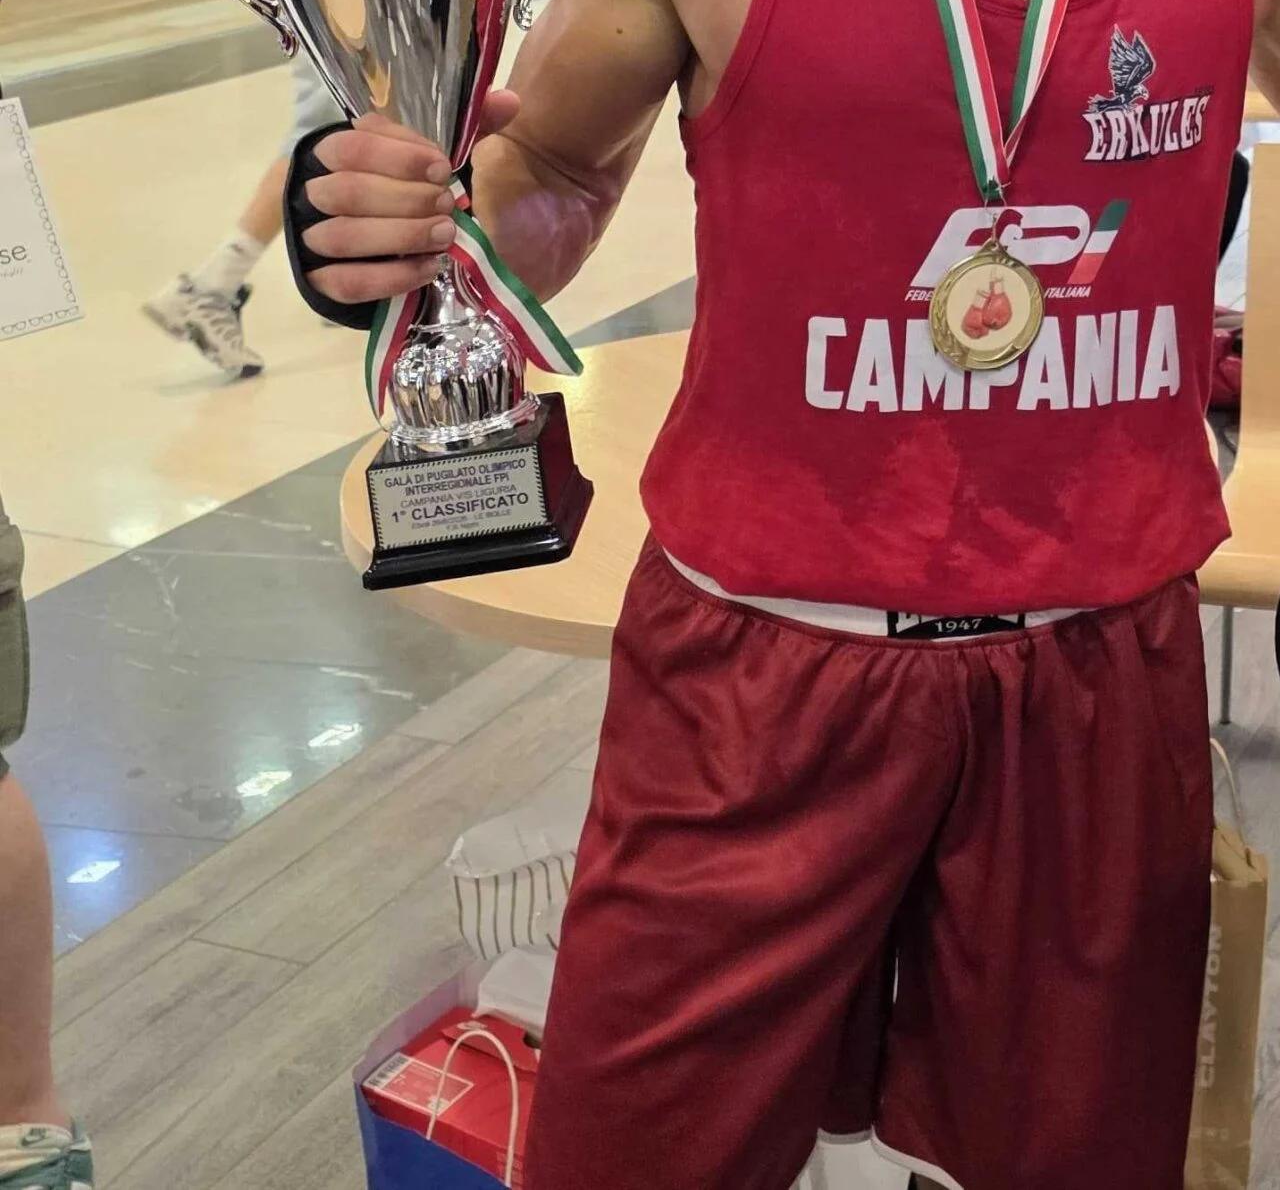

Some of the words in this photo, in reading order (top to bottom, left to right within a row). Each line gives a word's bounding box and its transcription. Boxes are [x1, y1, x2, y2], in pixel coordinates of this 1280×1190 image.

[1083, 94, 1212, 162] ERKULES
[414, 473, 425, 484] DI
[427, 466, 477, 483] PUGILATO
[479, 458, 526, 473] OLIMPICO
[400, 492, 454, 509] CAMPANIA
[474, 484, 517, 498] LIGURIA
[405, 474, 492, 496] INTERREGIONALE
[494, 472, 510, 484] FPI
[411, 492, 529, 521] CLASSIFICATO
[935, 618, 983, 633] 1947
